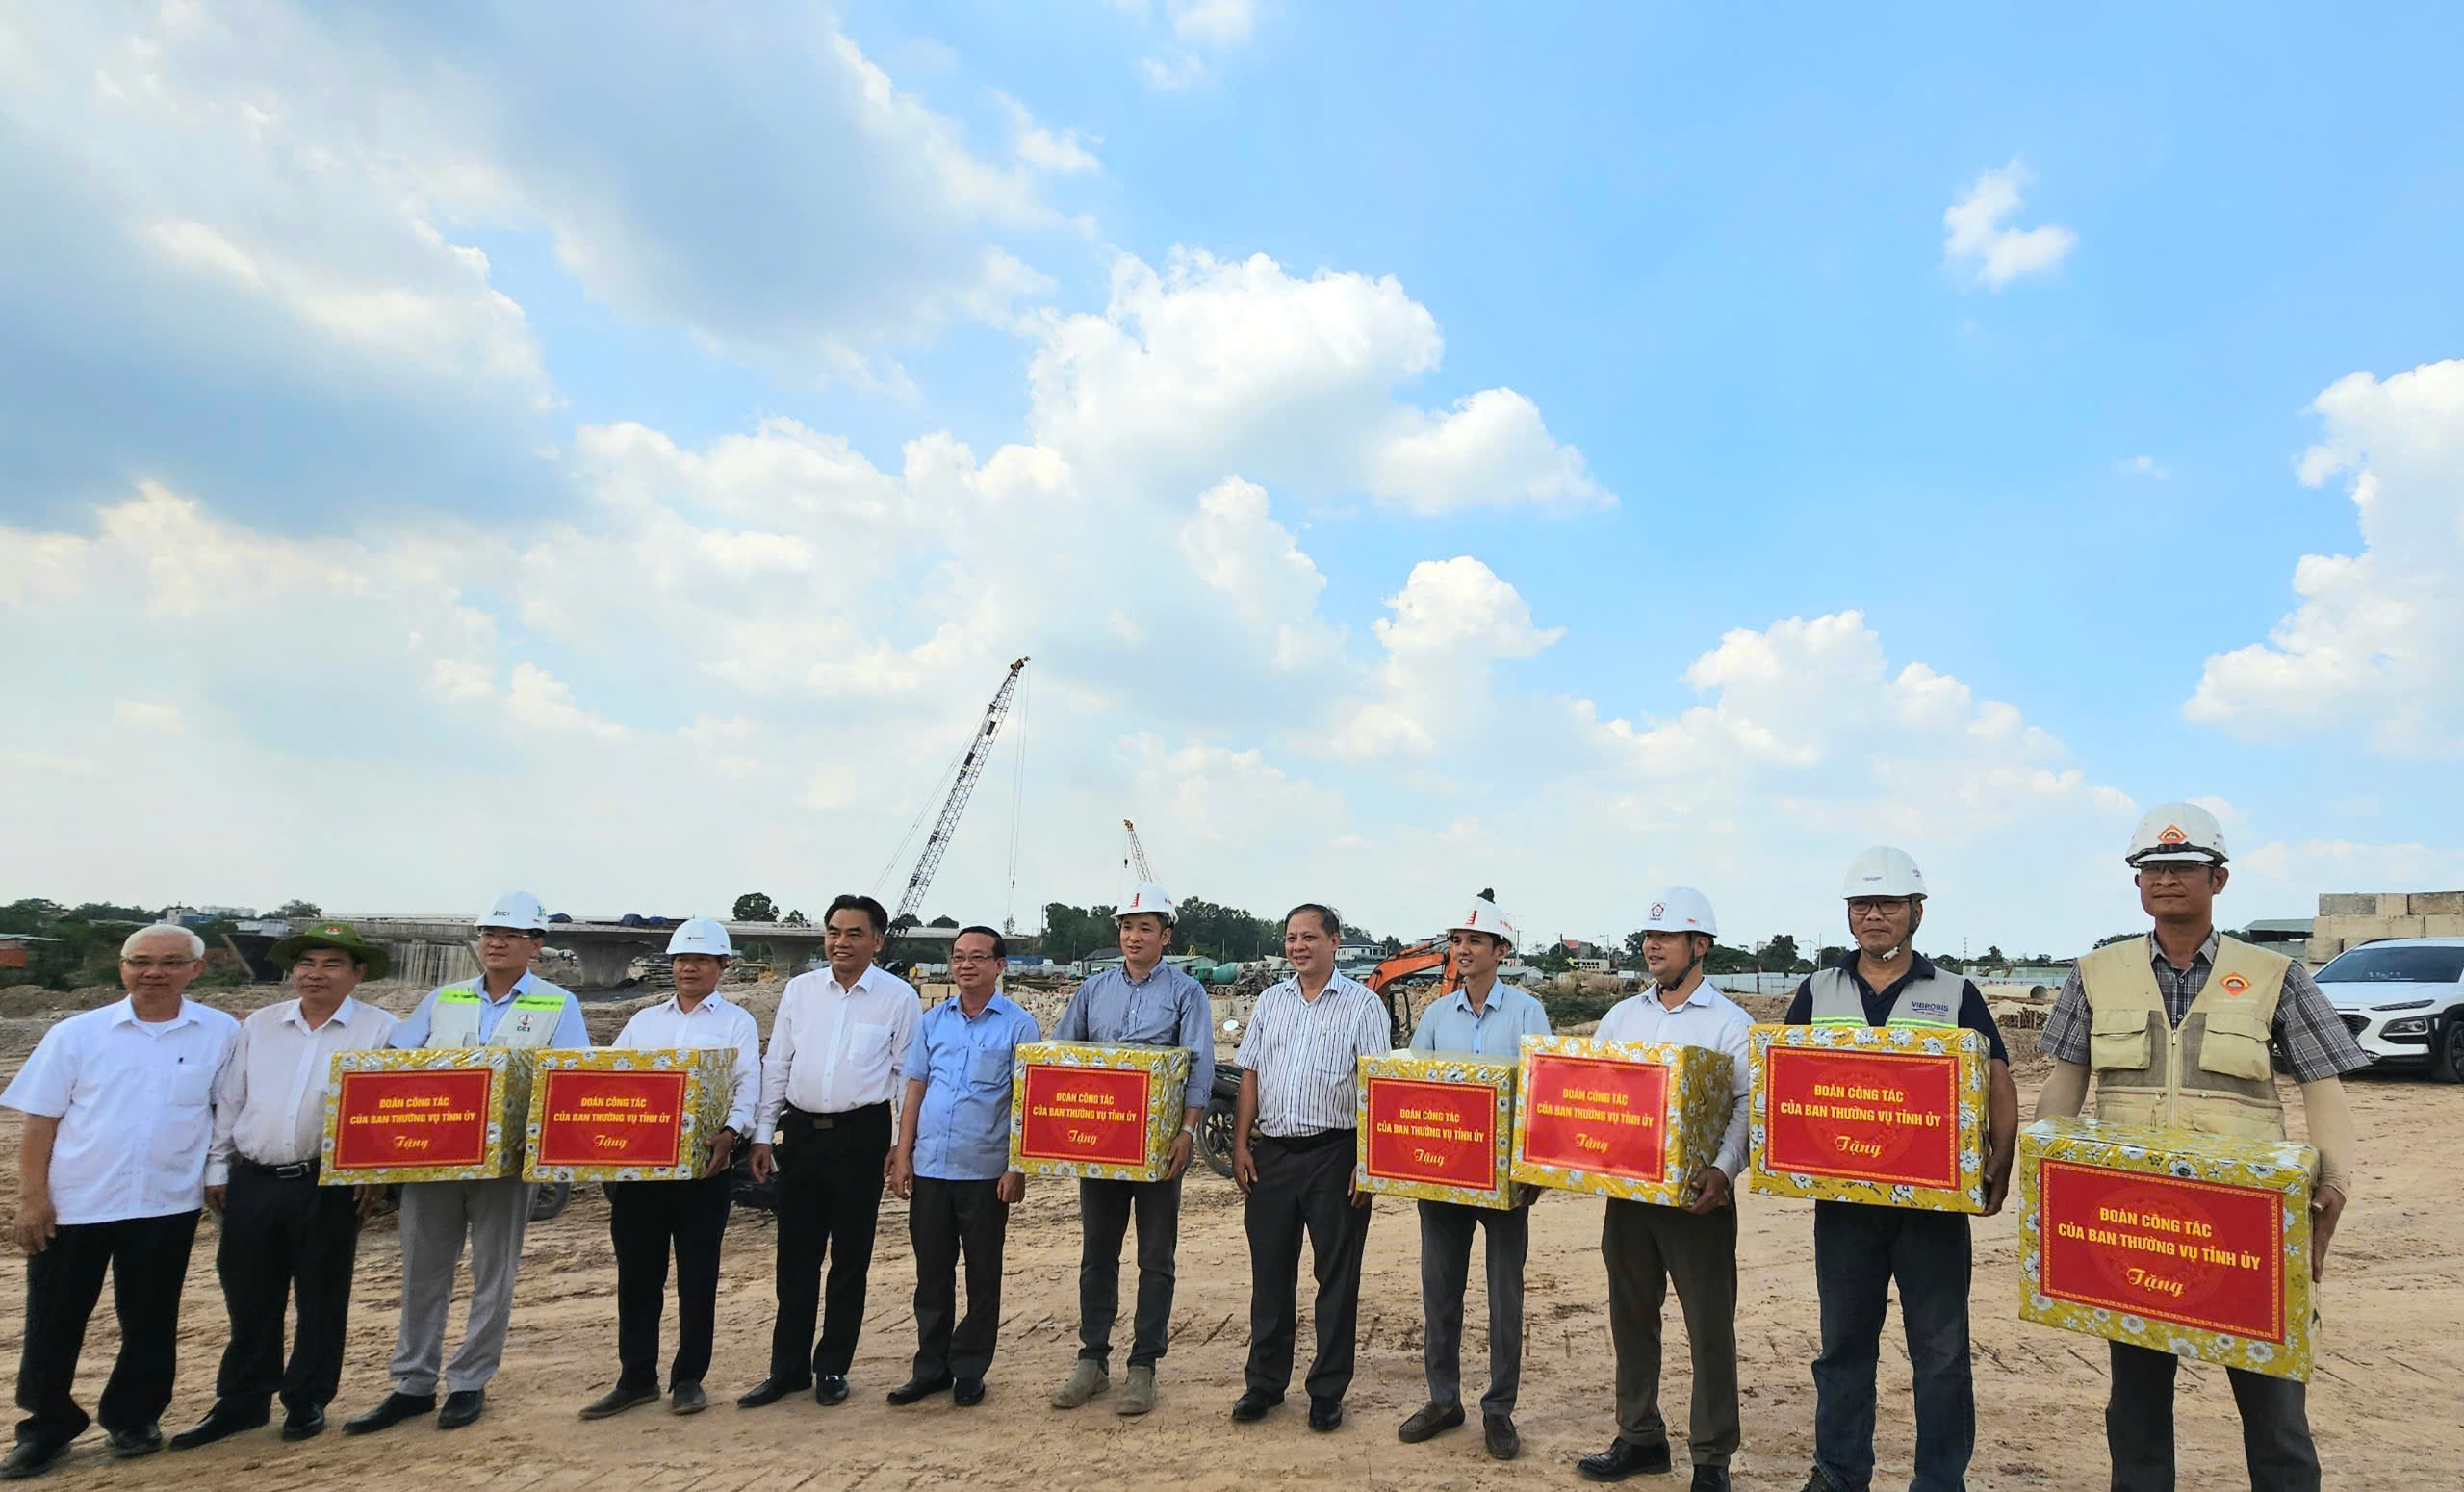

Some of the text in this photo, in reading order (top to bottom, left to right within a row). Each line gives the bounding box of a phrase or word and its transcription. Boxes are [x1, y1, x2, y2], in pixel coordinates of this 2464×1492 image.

[378, 1095, 450, 1109] ĐOÀN CÔNG TÁC
[580, 1095, 648, 1109] ĐOÀN CÔNG TÁC
[1056, 1092, 1115, 1106] ĐOÀN CÔNG TÁC
[1562, 1087, 1629, 1106] ĐOÀN CÔNG TÁC
[1813, 1083, 1904, 1103] ĐOÀN CÔNG TÁC
[349, 1109, 476, 1125] CỦA BAN THƯỜNG VỤ TỈNH ỦY
[553, 1110, 671, 1125] CỦA BAN THƯỜNG VỤ TỈNH ỦY
[1032, 1104, 1137, 1122] CỦA BAN THƯỜNG VỤ TỈNH ỦY
[1399, 1108, 1460, 1123] ĐOÀN CÔNG TÁC
[1536, 1100, 1655, 1128] CỦA BAN THƯỜNG VỤ TỈNH ỦY
[1780, 1099, 1941, 1128] CỦA BAN THƯỜNG VỤ TỈNH ỦY
[1067, 1129, 1097, 1146] Tặng
[1376, 1119, 1484, 1143] CỦA BAN THƯỜNG VỤ TỈNH ỦY
[394, 1135, 429, 1150] Tặng
[593, 1134, 628, 1150] Tặng
[1576, 1132, 1609, 1154] Tặng
[1835, 1135, 1882, 1159] Tặng
[1413, 1148, 1445, 1168] Tặng
[2099, 1207, 2212, 1238] ĐOÀN CÔNG TÁC
[2058, 1221, 2261, 1271] CỦA BAN THƯỜNG VỤ TỈNH ỦY
[2126, 1267, 2184, 1298] Tặng
